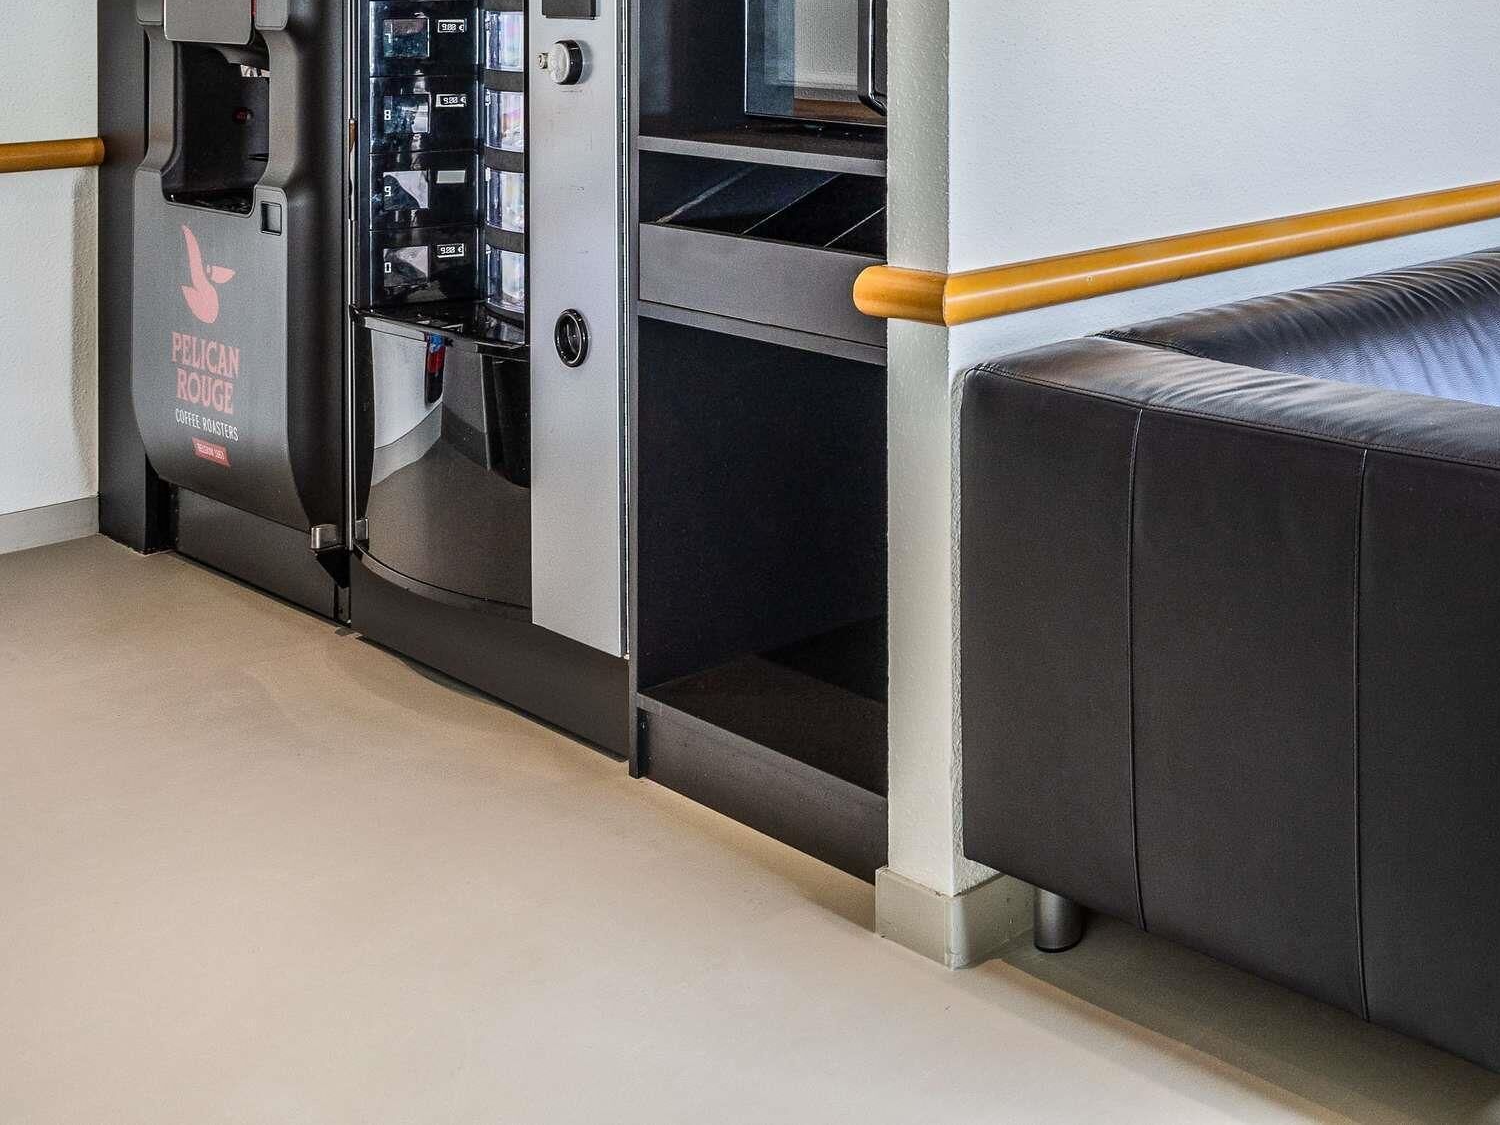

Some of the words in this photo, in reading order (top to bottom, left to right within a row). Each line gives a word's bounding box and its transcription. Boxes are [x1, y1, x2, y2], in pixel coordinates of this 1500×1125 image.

[171, 331, 240, 379] PELICAN
[176, 368, 234, 414] ROUGE
[175, 408, 200, 430] COFFEE
[202, 416, 239, 442] ROASTERS
